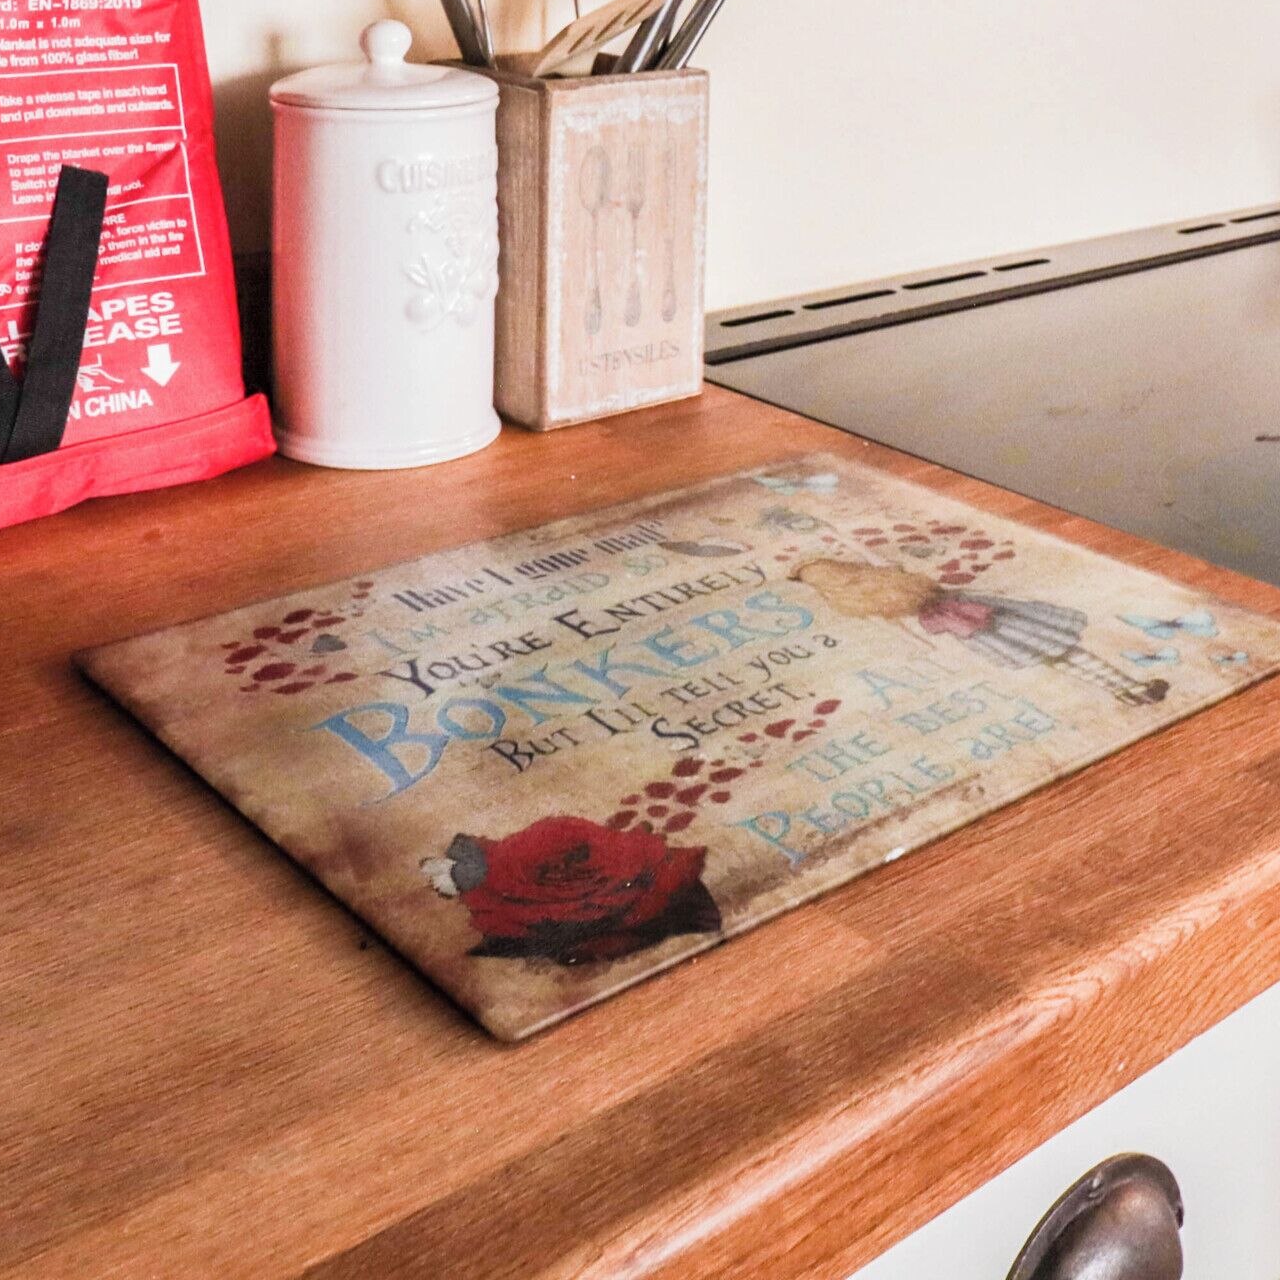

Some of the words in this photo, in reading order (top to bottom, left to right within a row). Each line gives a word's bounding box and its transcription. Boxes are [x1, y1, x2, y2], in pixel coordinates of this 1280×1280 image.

[38, 37, 49, 49] is
[51, 36, 72, 49] not
[74, 35, 128, 48] adequate
[129, 33, 152, 45] size
[154, 31, 171, 43] for
[10, 54, 39, 67] from
[41, 52, 74, 64] 100%
[75, 51, 107, 65] glass
[26, 96, 33, 105] a
[35, 91, 75, 103] release
[77, 89, 101, 101] tape
[103, 87, 113, 98] in
[115, 85, 140, 97] each
[142, 84, 167, 95] hand
[0, 111, 22, 123] and
[24, 109, 44, 123] pull
[46, 104, 105, 119] downwards
[107, 102, 126, 113] and
[7, 151, 40, 164] Drape
[43, 149, 60, 161] the
[62, 146, 100, 159] blanket
[102, 145, 125, 156] over
[127, 143, 144, 154] the
[9, 167, 21, 177] to
[23, 165, 45, 176] seal
[11, 179, 47, 191] Switch
[13, 193, 44, 205] Leave
[116, 224, 145, 236] force
[146, 220, 176, 231] victim
[177, 218, 187, 228] to
[108, 239, 136, 251] them
[138, 236, 148, 246] in
[149, 233, 167, 244] the
[168, 231, 184, 242] fire
[100, 249, 142, 265] medical
[144, 247, 160, 258] aid
[162, 244, 180, 256] and
[87, 292, 175, 322] APES
[84, 389, 154, 417] CHINA
